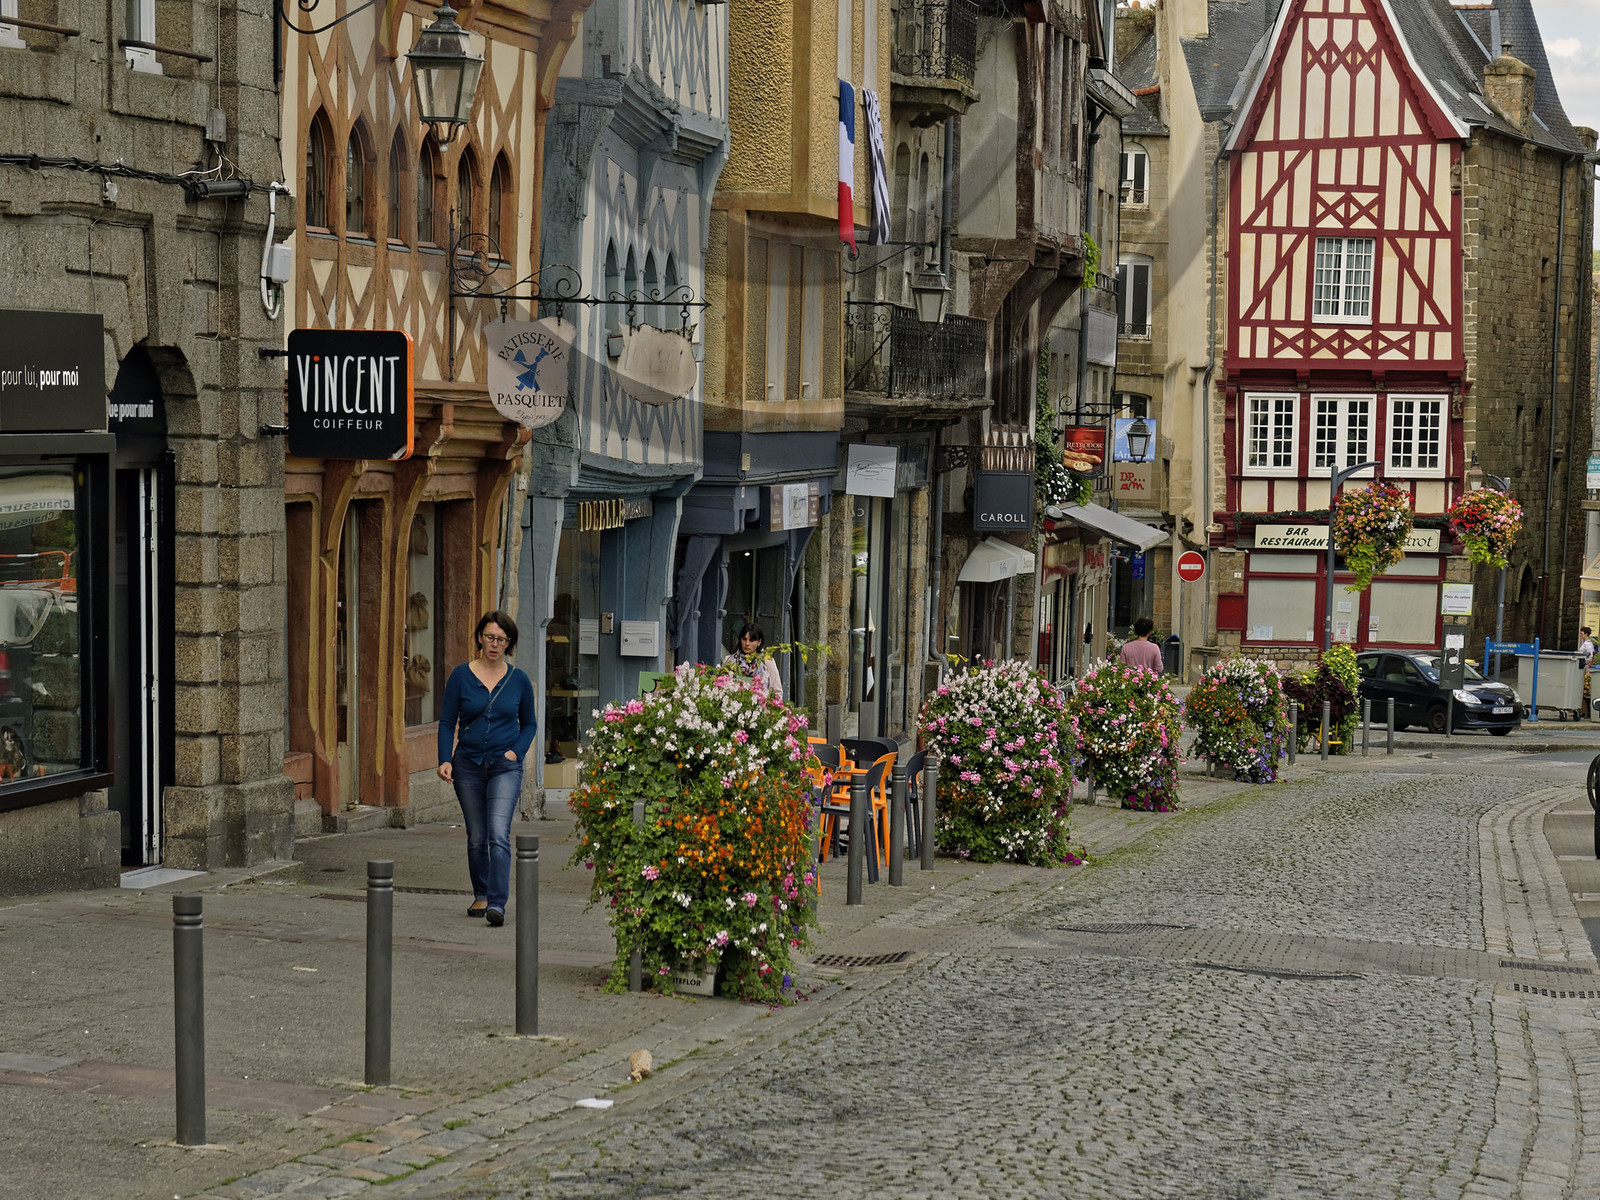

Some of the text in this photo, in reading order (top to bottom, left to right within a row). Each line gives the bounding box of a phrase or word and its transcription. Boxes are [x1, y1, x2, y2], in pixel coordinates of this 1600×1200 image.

[498, 332, 565, 364] PATISSERIE
[1, 365, 79, 391] pour lui, pour moi
[497, 393, 567, 408] PASQUIET
[118, 403, 138, 422] pour
[138, 400, 154, 418] moi
[313, 418, 383, 430] COIFFEUR
[980, 513, 1026, 523] CAROLL
[1285, 527, 1309, 536] BAR
